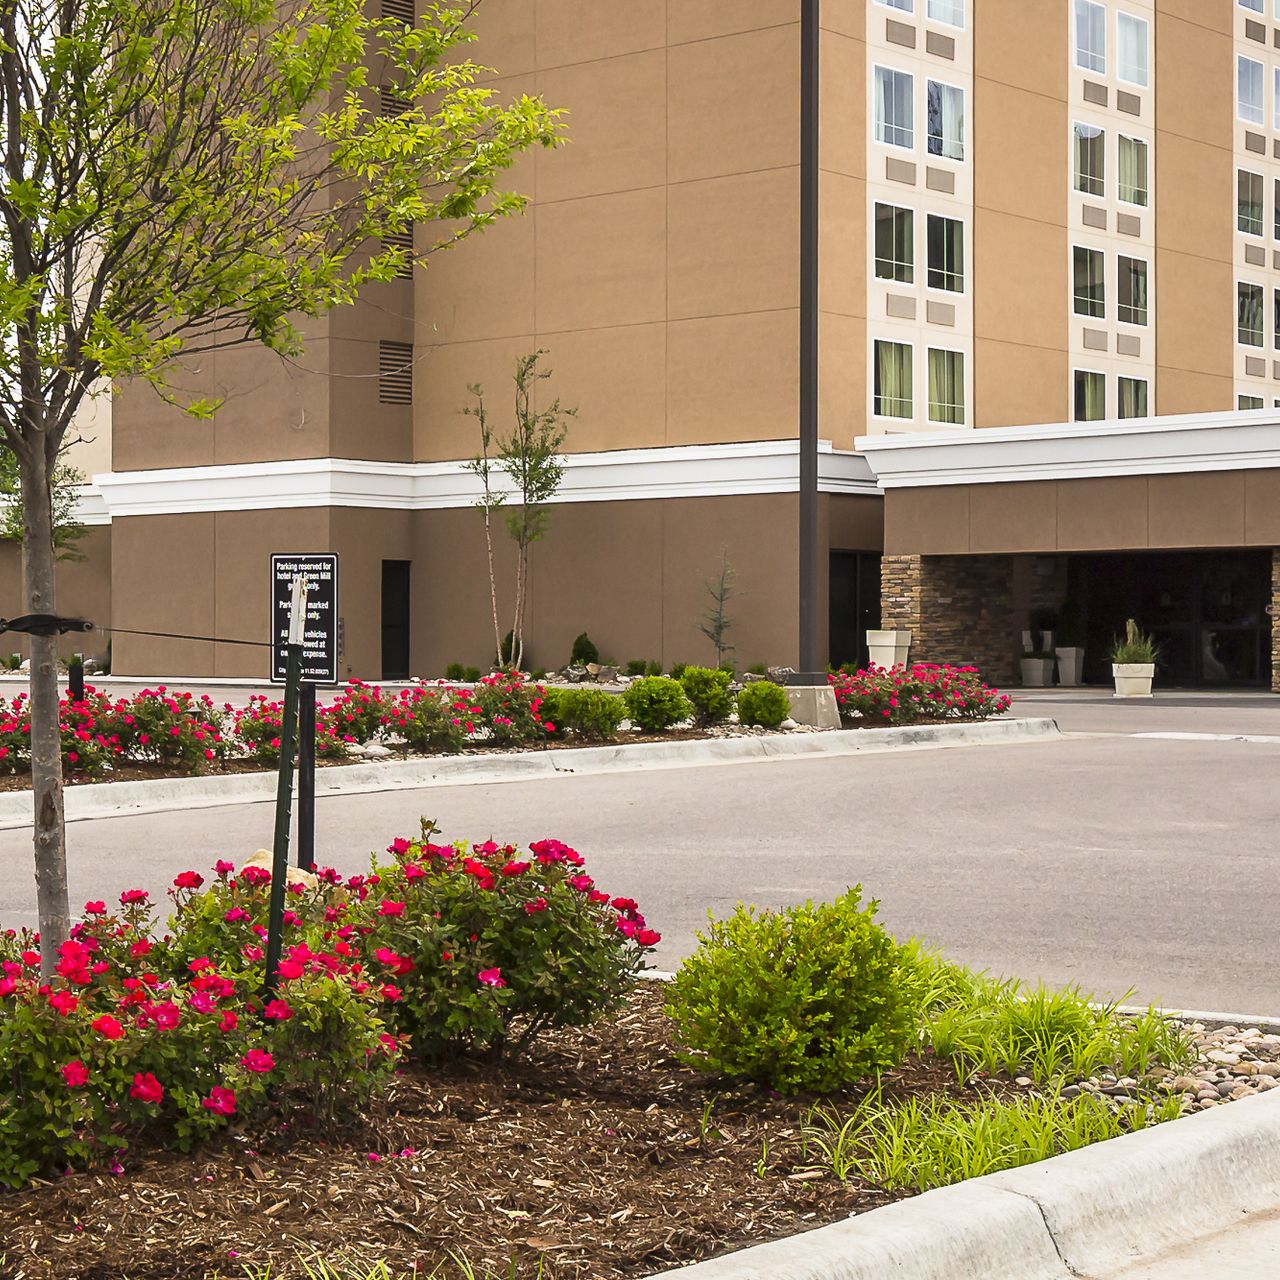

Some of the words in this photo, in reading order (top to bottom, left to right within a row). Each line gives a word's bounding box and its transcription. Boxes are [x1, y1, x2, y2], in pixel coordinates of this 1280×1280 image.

[276, 562, 298, 572] Parking
[298, 562, 322, 571] reserved
[323, 562, 332, 571] for
[276, 571, 292, 580] hotel
[292, 571, 303, 580] and
[303, 571, 320, 580] Green
[320, 571, 332, 580] Mill
[306, 582, 320, 592] only.
[307, 600, 329, 609] marked
[307, 610, 321, 621] only.
[304, 630, 328, 639] vehicles
[302, 640, 319, 649] owed
[319, 640, 326, 649] at
[302, 650, 328, 659] expense.
